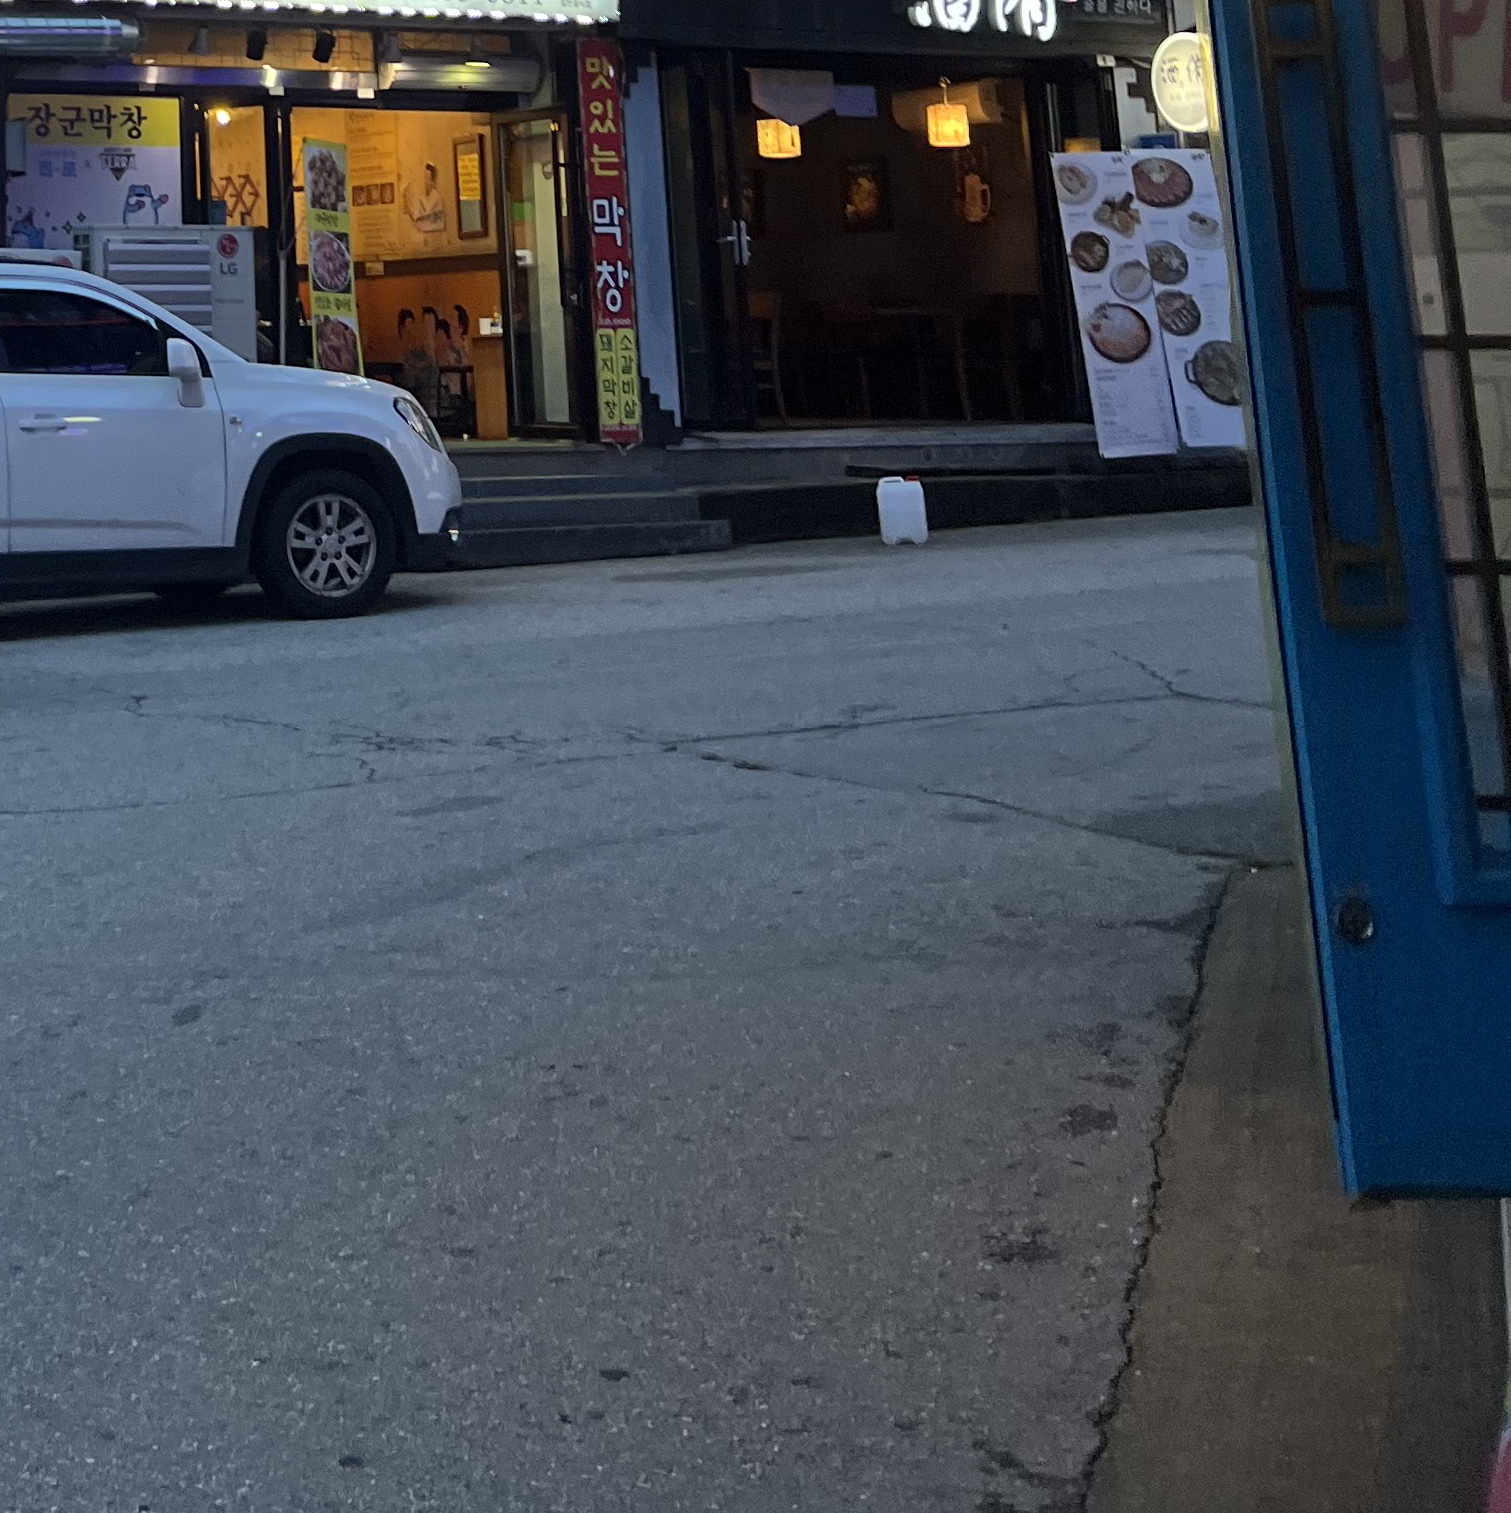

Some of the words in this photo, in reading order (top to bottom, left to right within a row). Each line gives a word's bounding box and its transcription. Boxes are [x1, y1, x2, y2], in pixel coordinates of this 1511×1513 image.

[26, 103, 148, 140] 장군막창
[585, 55, 620, 178] 맛있는
[219, 261, 238, 276] LG
[590, 194, 632, 313] 막창
[598, 332, 617, 420] 돼지막창
[620, 334, 638, 420] 소갈비살
